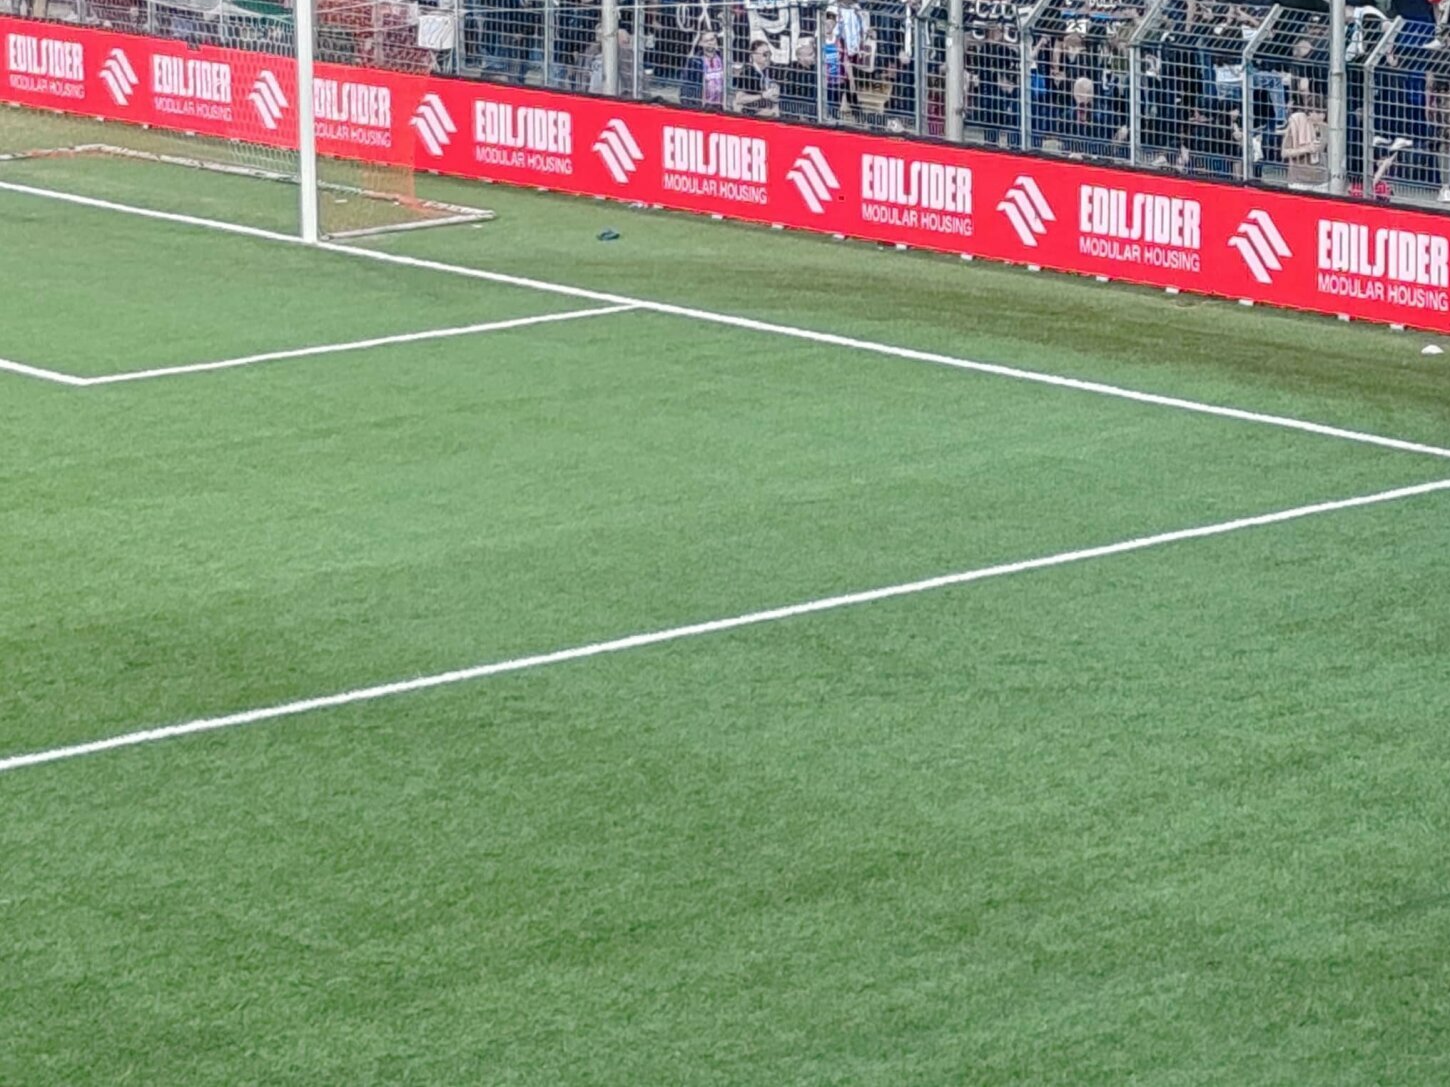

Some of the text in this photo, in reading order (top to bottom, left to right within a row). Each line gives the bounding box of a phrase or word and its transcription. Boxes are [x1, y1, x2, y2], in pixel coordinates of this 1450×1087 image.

[7, 33, 84, 81] EDILSIDER
[151, 54, 232, 103] EDILSIDER
[312, 78, 391, 128] DILSIDER
[475, 100, 571, 154] EDILSIDER
[476, 146, 573, 174] MODULAR HOUSING
[663, 126, 766, 183] EDILSIDER
[664, 173, 768, 204] MODULAR HOUSING
[862, 154, 972, 214] EDILSIDER
[862, 203, 972, 235] MODULAR HOUSING
[1080, 185, 1200, 249] EDILSIDER
[1080, 237, 1200, 272] MODULAR HOUSING
[1318, 220, 1448, 287] EDILSIDER
[1318, 273, 1449, 312] MODULAR HOUSING
